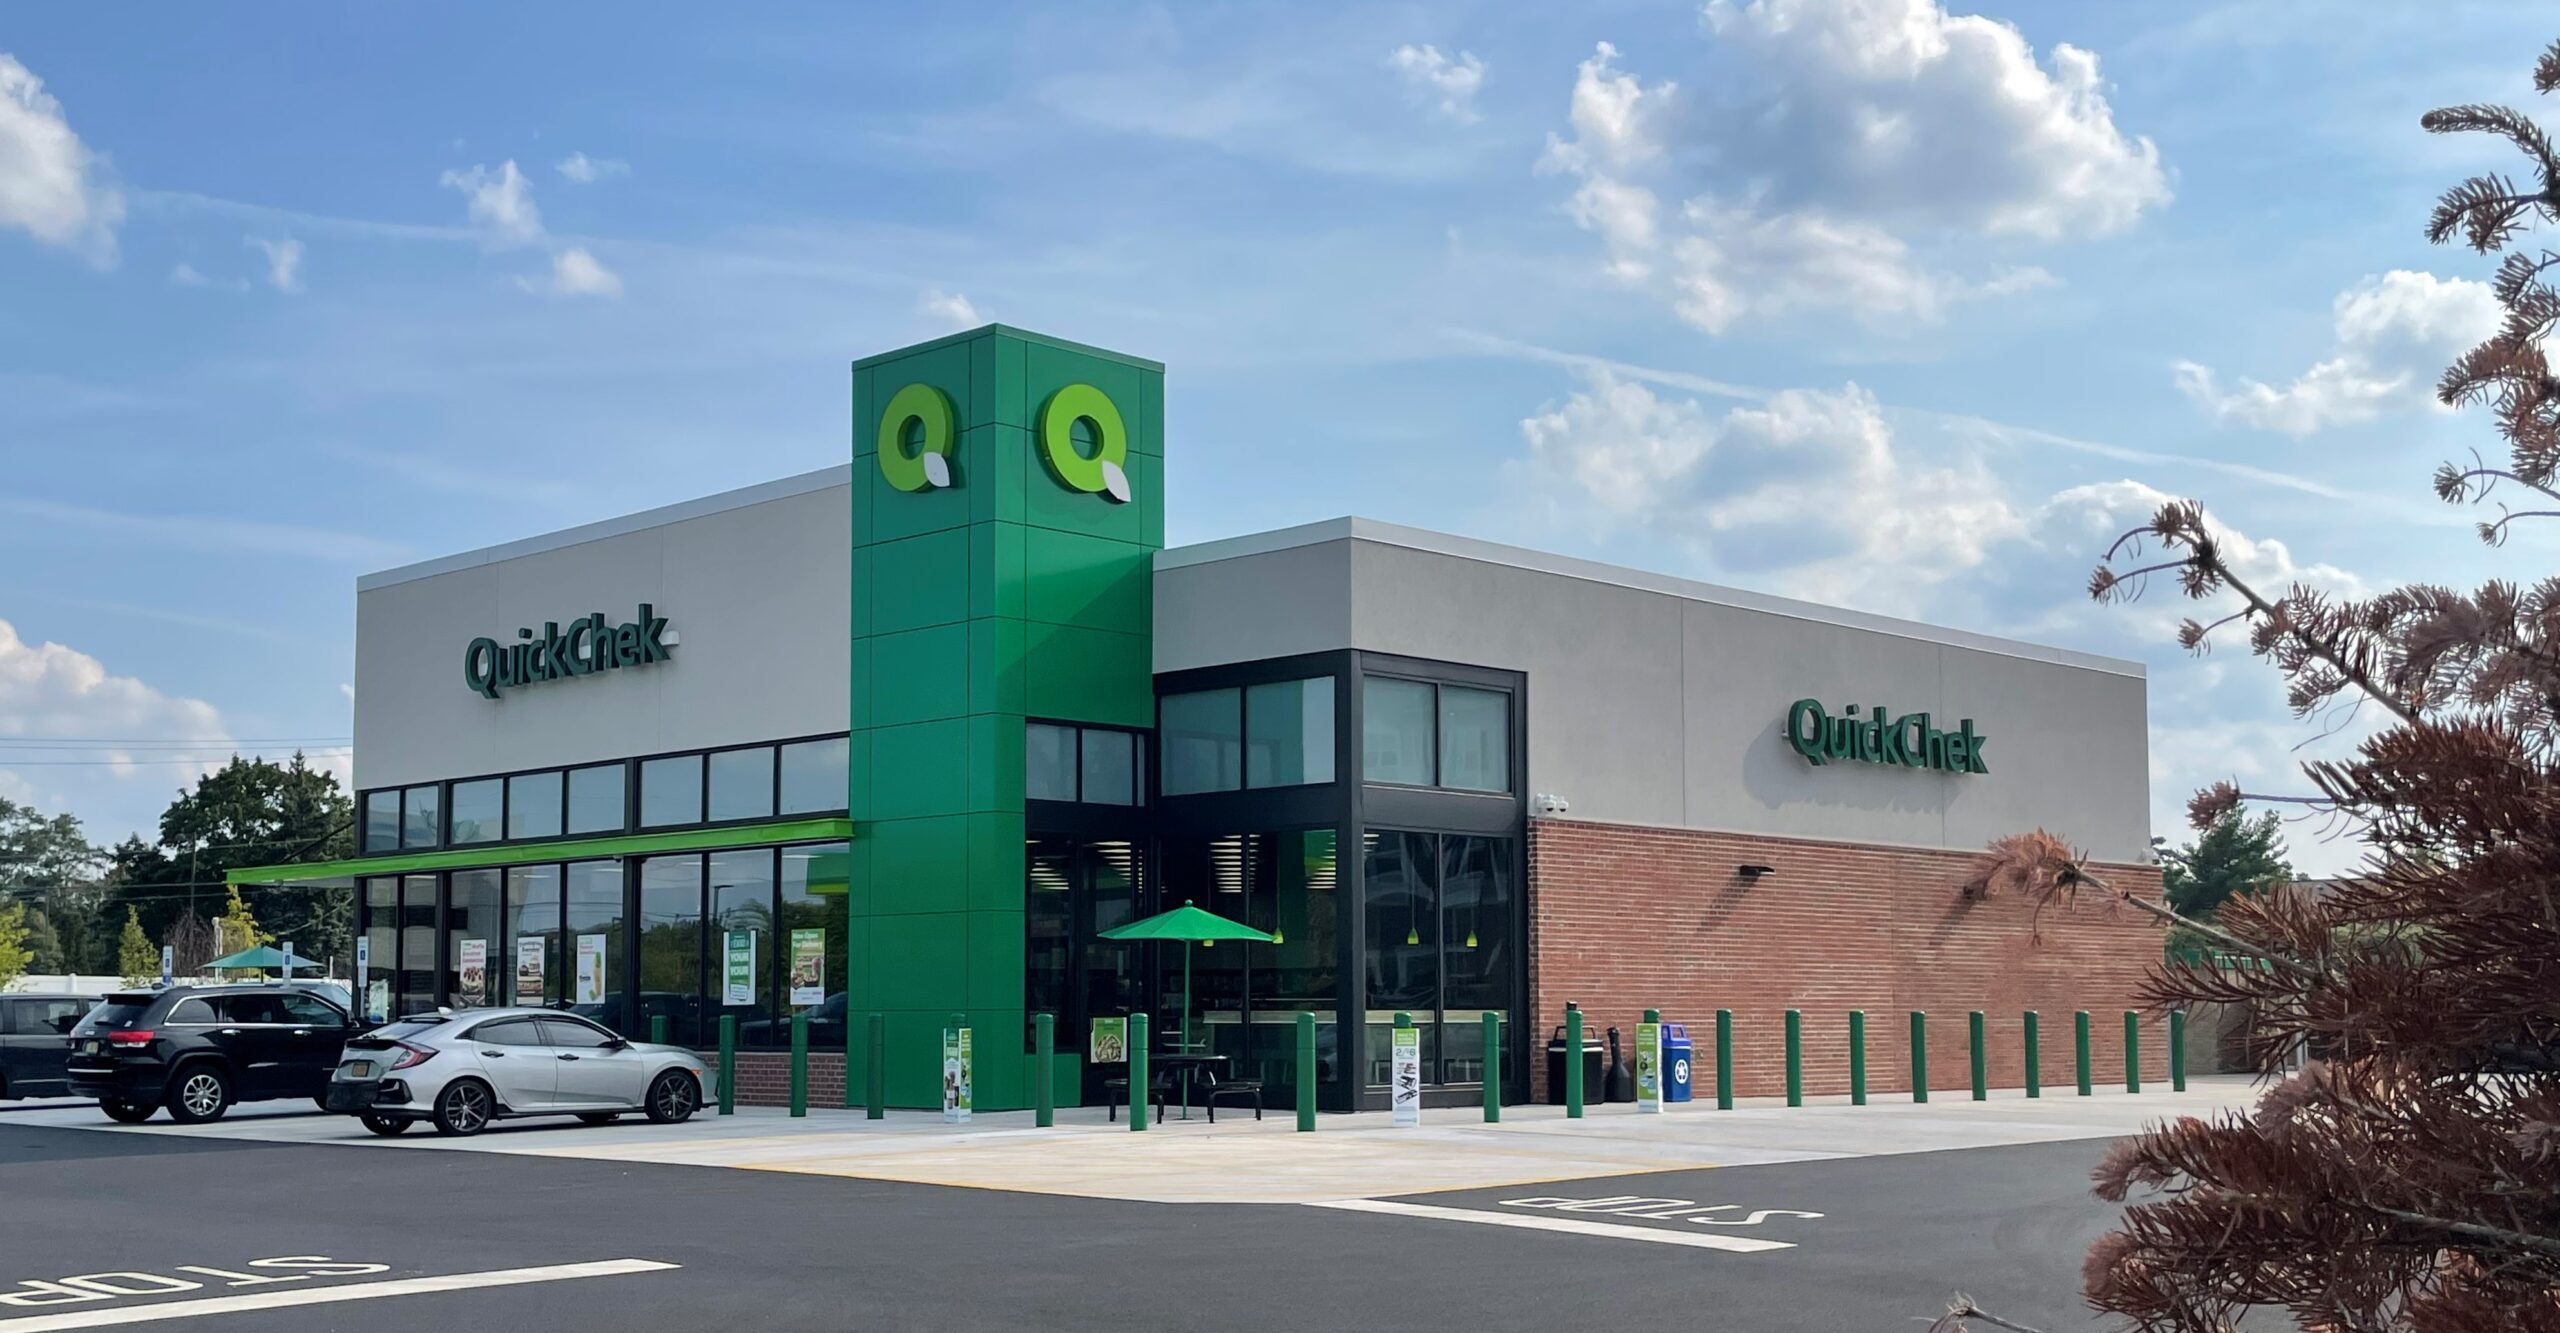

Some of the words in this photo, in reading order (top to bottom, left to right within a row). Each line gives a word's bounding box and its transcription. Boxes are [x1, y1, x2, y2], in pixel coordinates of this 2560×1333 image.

[465, 603, 671, 699] QuickChek
[1788, 698, 1989, 774] QuickChek
[730, 952, 749, 962] YOUR
[730, 966, 749, 976] YOUR
[1498, 1196, 1825, 1225] STOP
[0, 1255, 391, 1306] STOP
